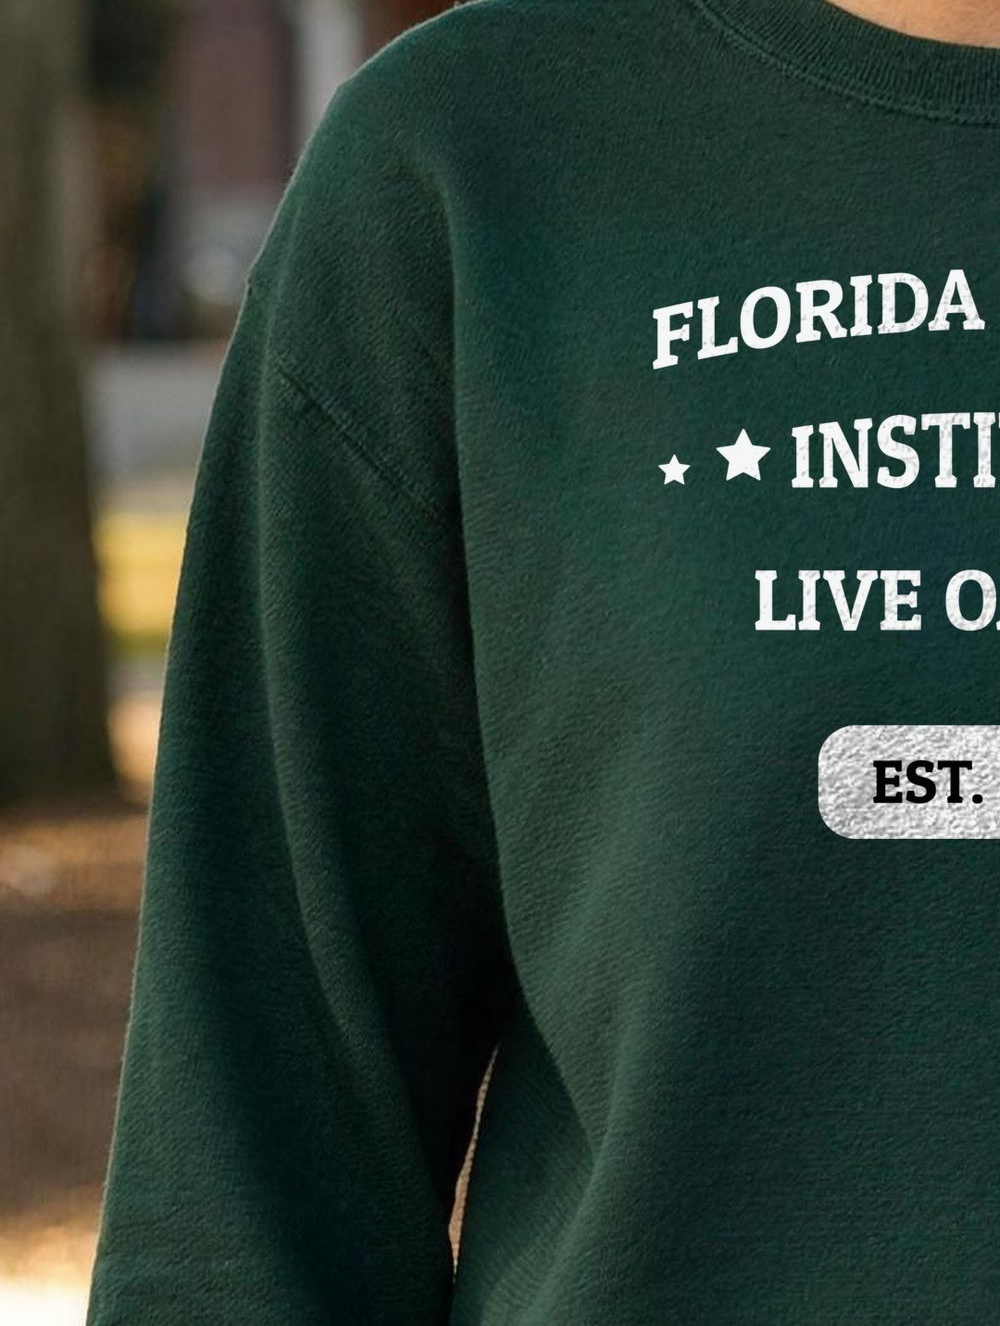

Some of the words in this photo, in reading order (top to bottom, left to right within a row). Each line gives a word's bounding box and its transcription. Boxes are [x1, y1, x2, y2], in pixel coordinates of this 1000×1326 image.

[652, 268, 986, 370] FLORIDA
[754, 569, 922, 631] LIVE
[872, 759, 983, 804] EST.
